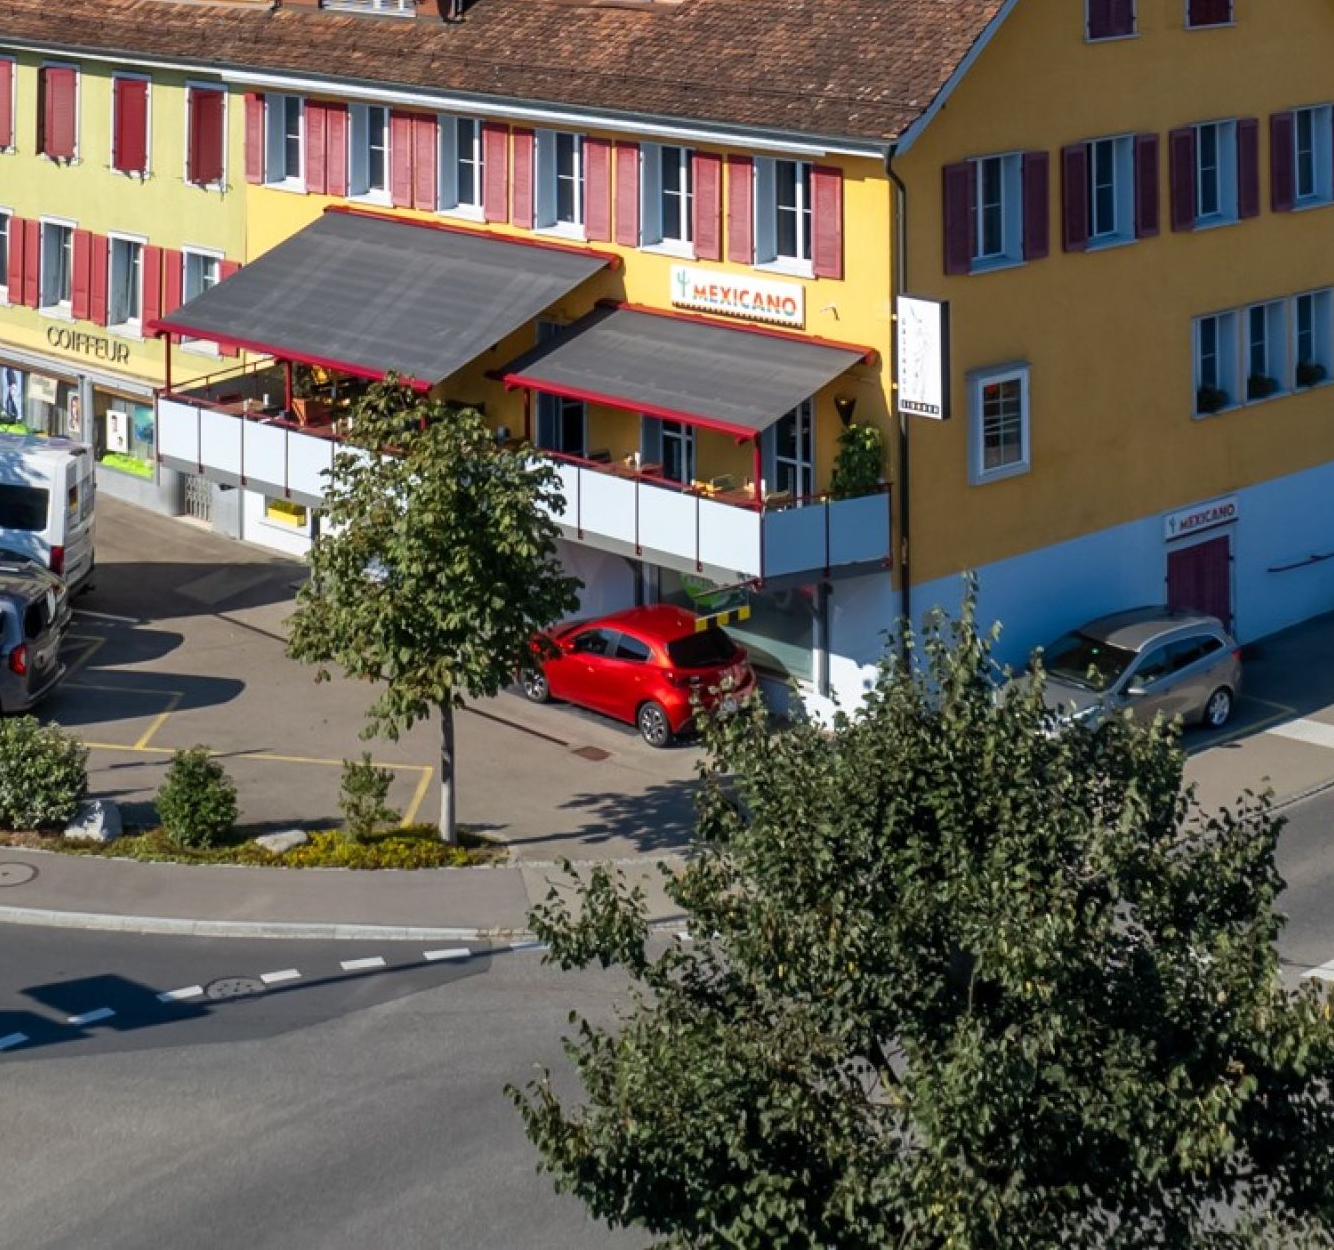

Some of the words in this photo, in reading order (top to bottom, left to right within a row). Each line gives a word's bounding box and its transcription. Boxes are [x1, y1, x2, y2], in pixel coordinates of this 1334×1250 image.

[692, 283, 797, 317] MEXICANO
[47, 325, 131, 364] COIFFEUR
[1178, 502, 1236, 530] MEXICANO
